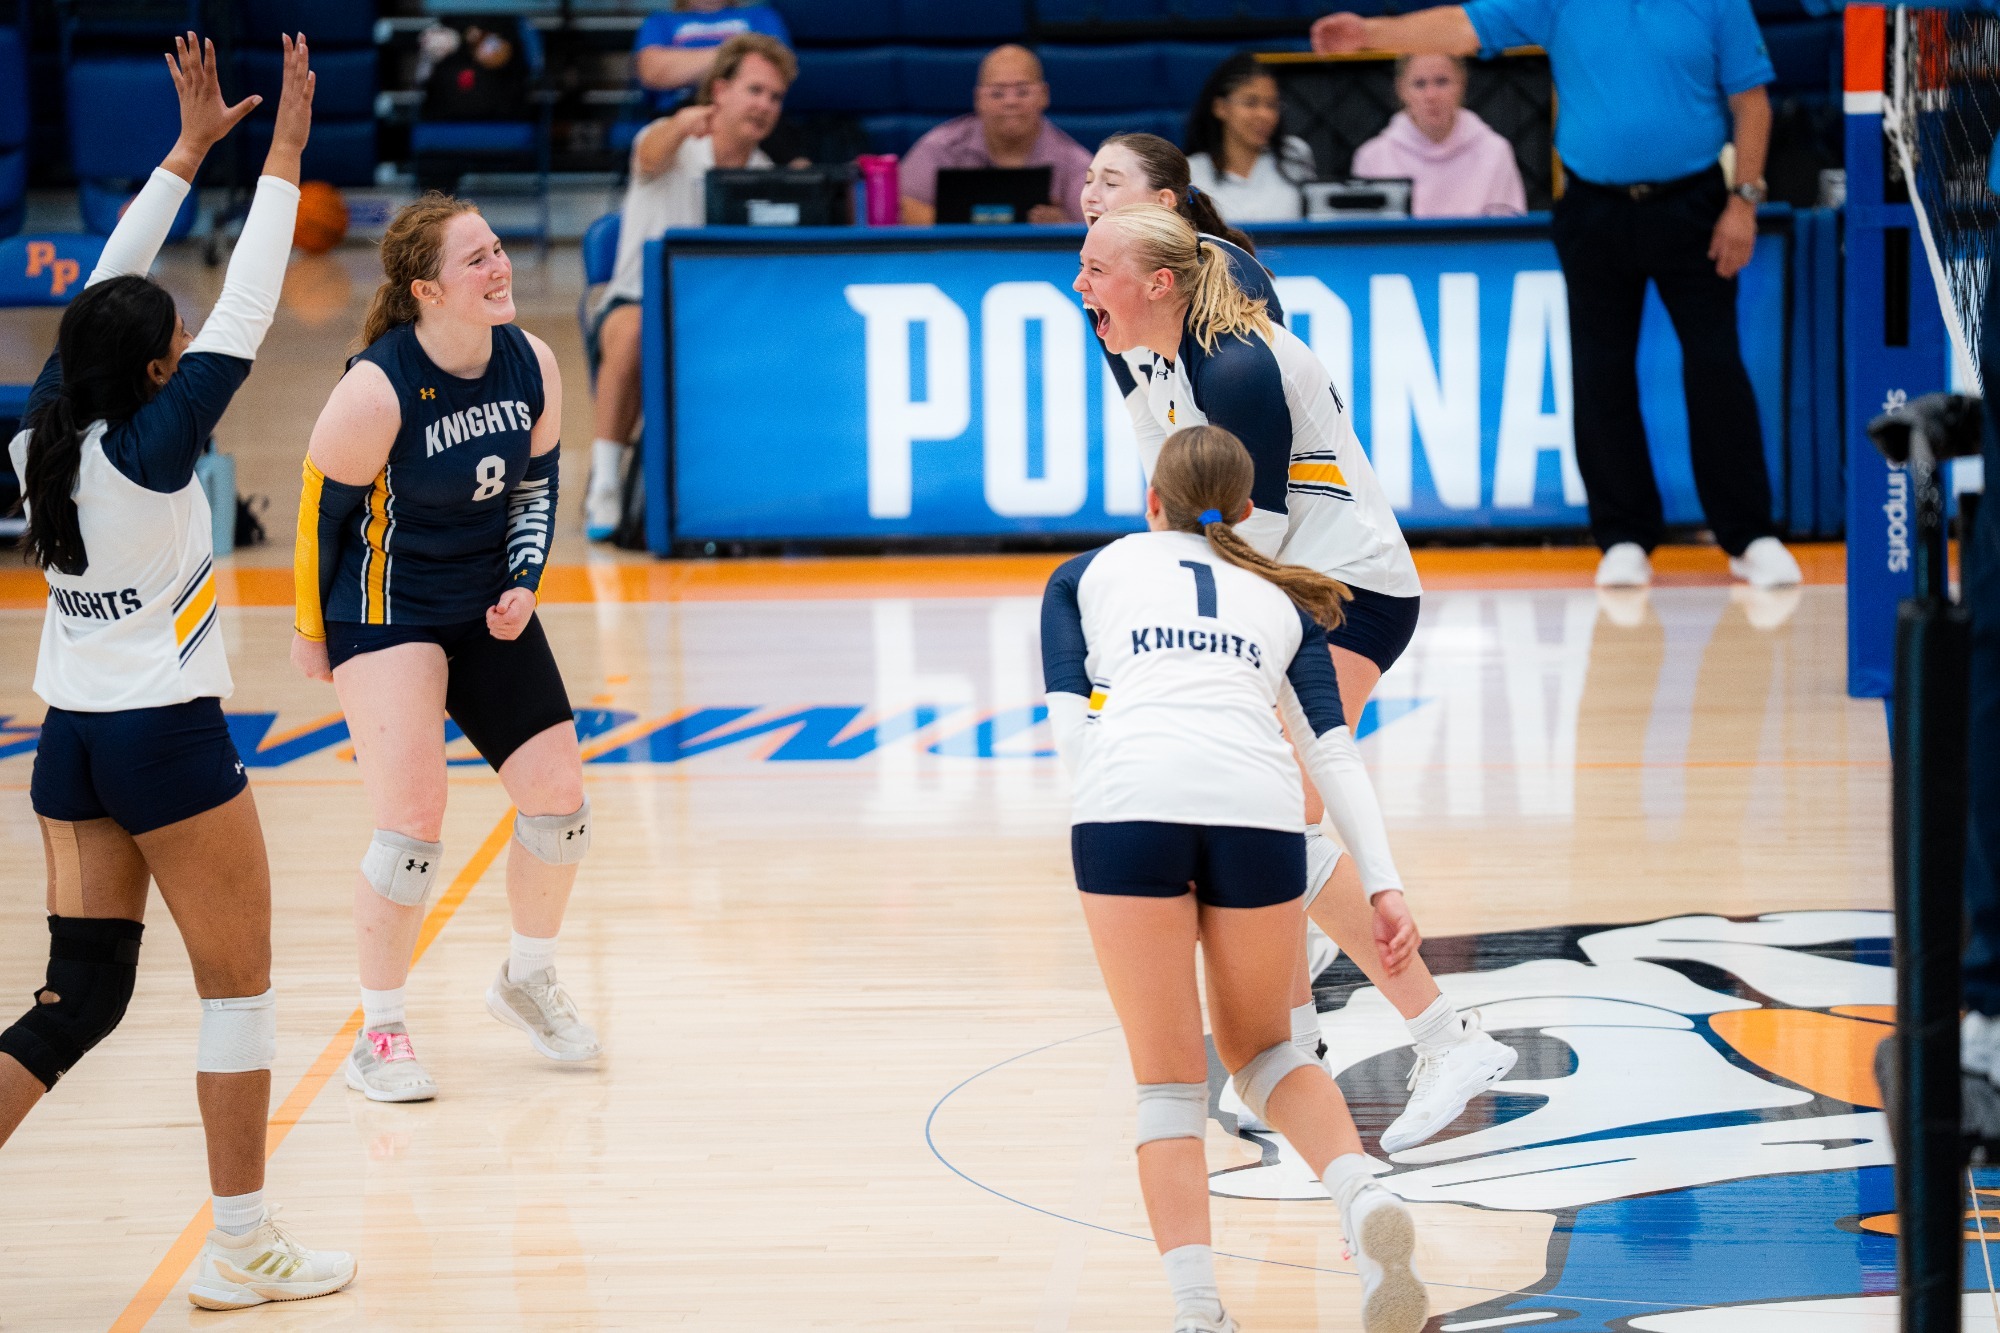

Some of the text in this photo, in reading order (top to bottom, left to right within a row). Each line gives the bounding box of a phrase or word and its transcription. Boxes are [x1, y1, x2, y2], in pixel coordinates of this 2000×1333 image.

[425, 400, 531, 459] KNIGHTS
[471, 454, 506, 502] 8
[48, 583, 142, 620] NIGHTS
[1179, 560, 1217, 618] 1
[1131, 627, 1261, 669] KNIGHTS
